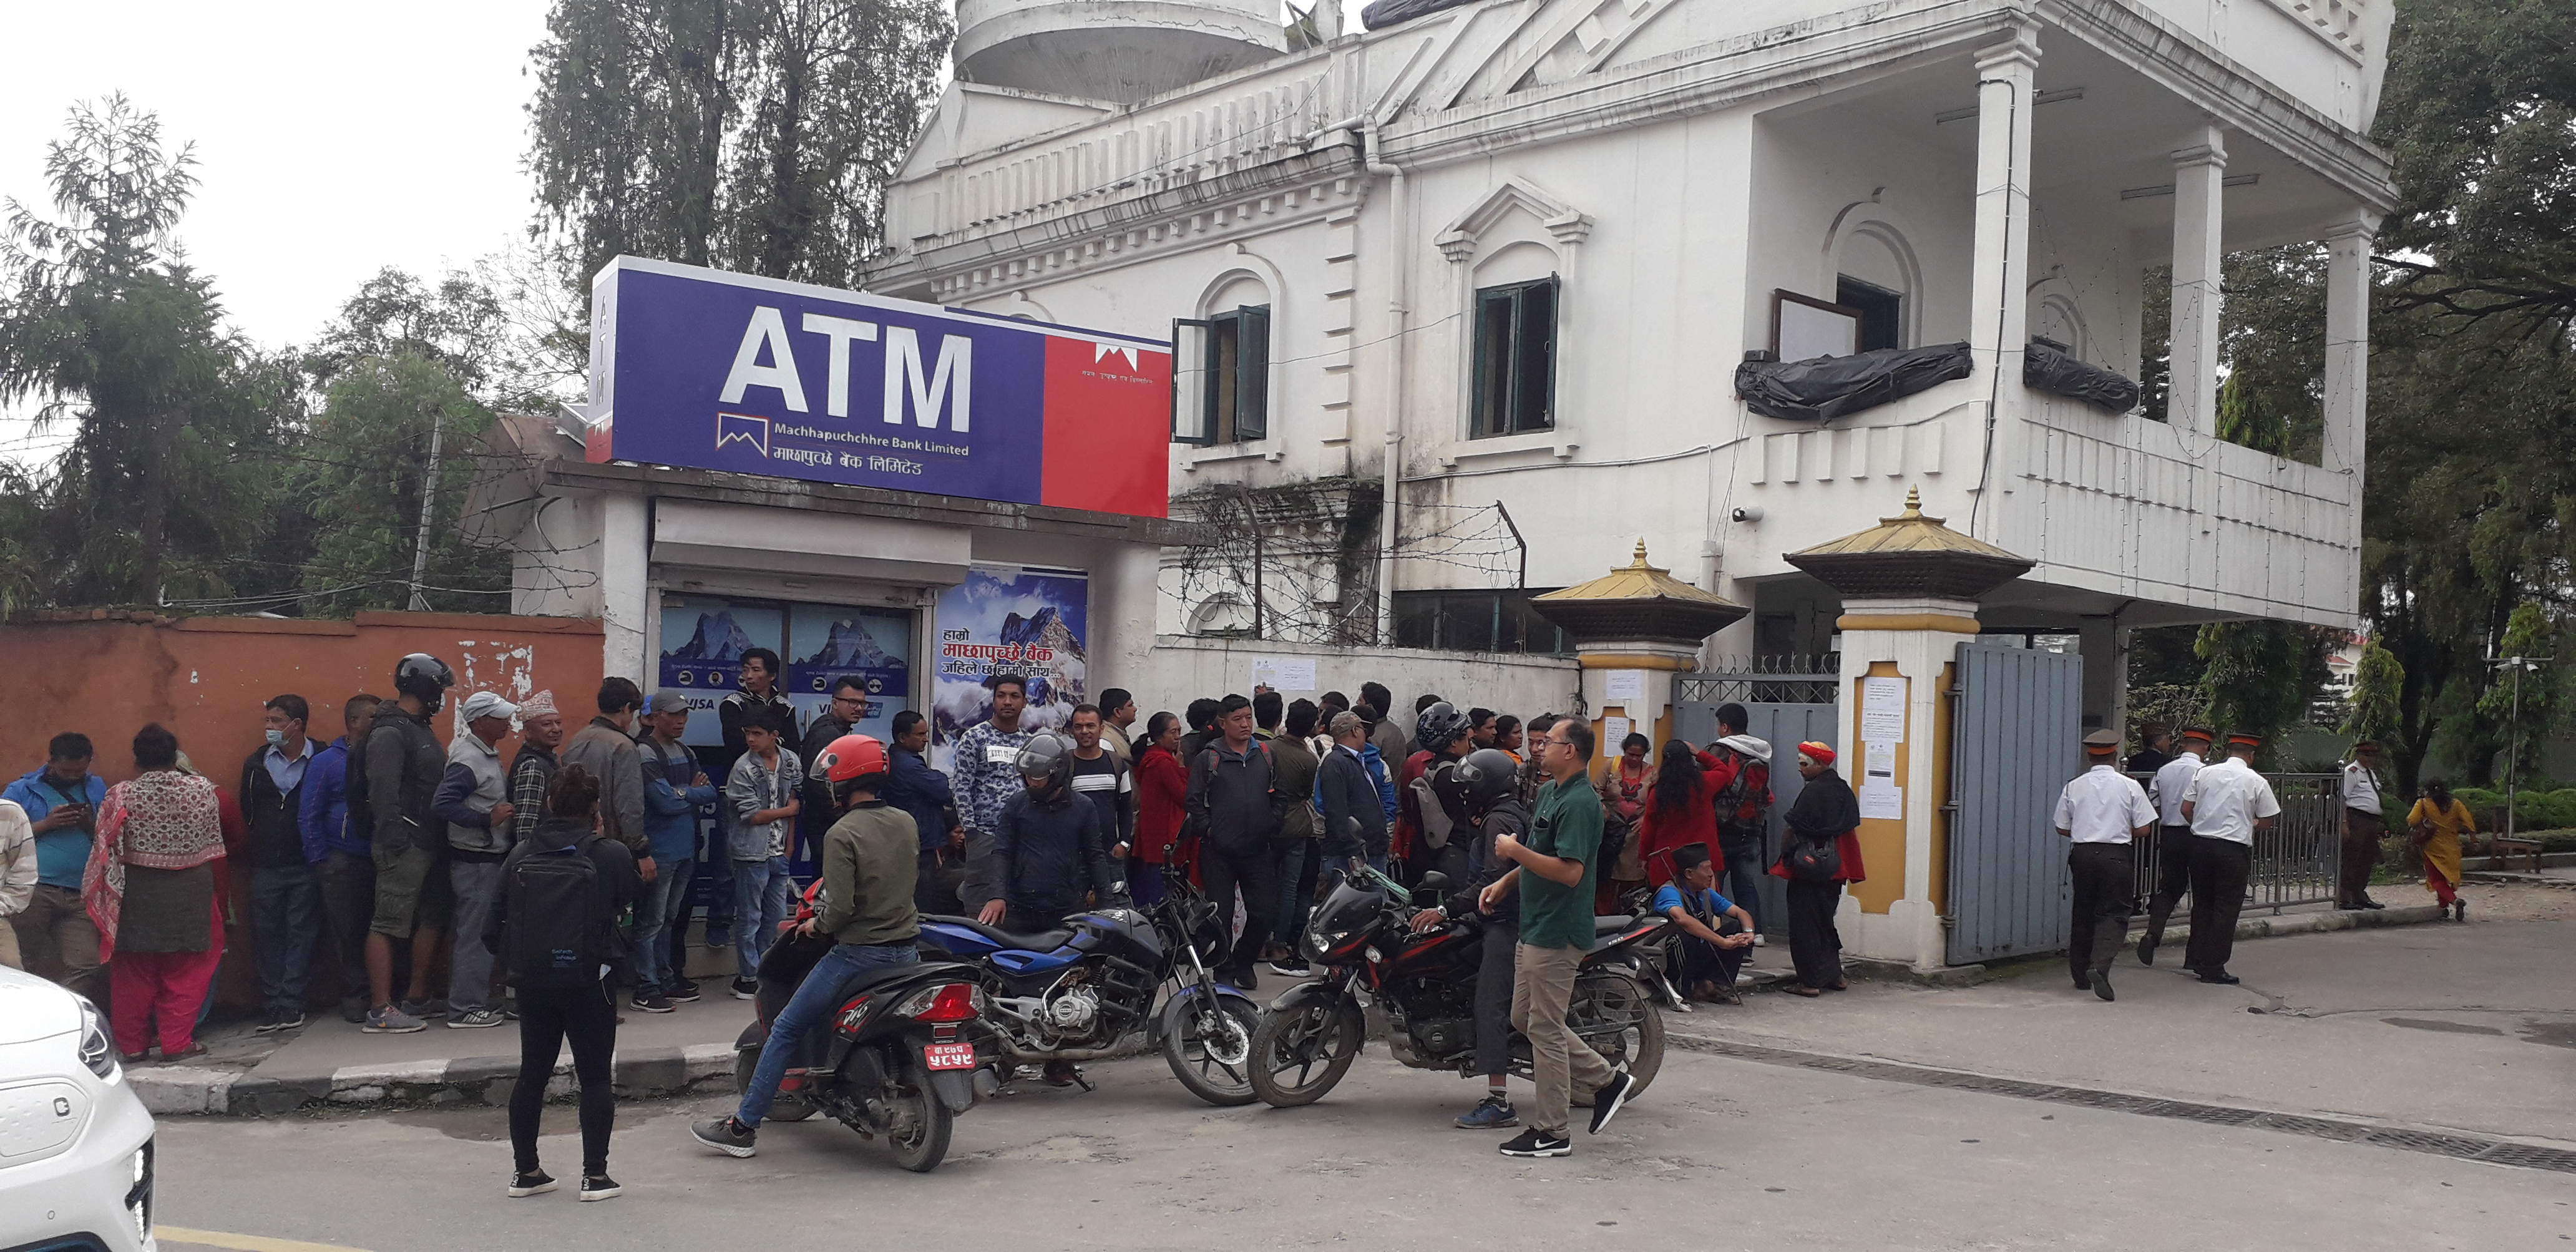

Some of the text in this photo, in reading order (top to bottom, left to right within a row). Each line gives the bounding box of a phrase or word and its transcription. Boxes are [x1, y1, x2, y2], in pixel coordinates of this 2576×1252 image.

[719, 306, 972, 433] ATM
[774, 423, 970, 456] Machhapuchchhre Bank Limited
[866, 455, 924, 475] लिमिटेड
[943, 627, 970, 642] हाम्रो
[942, 660, 978, 674] जहिले
[982, 665, 994, 675] छ
